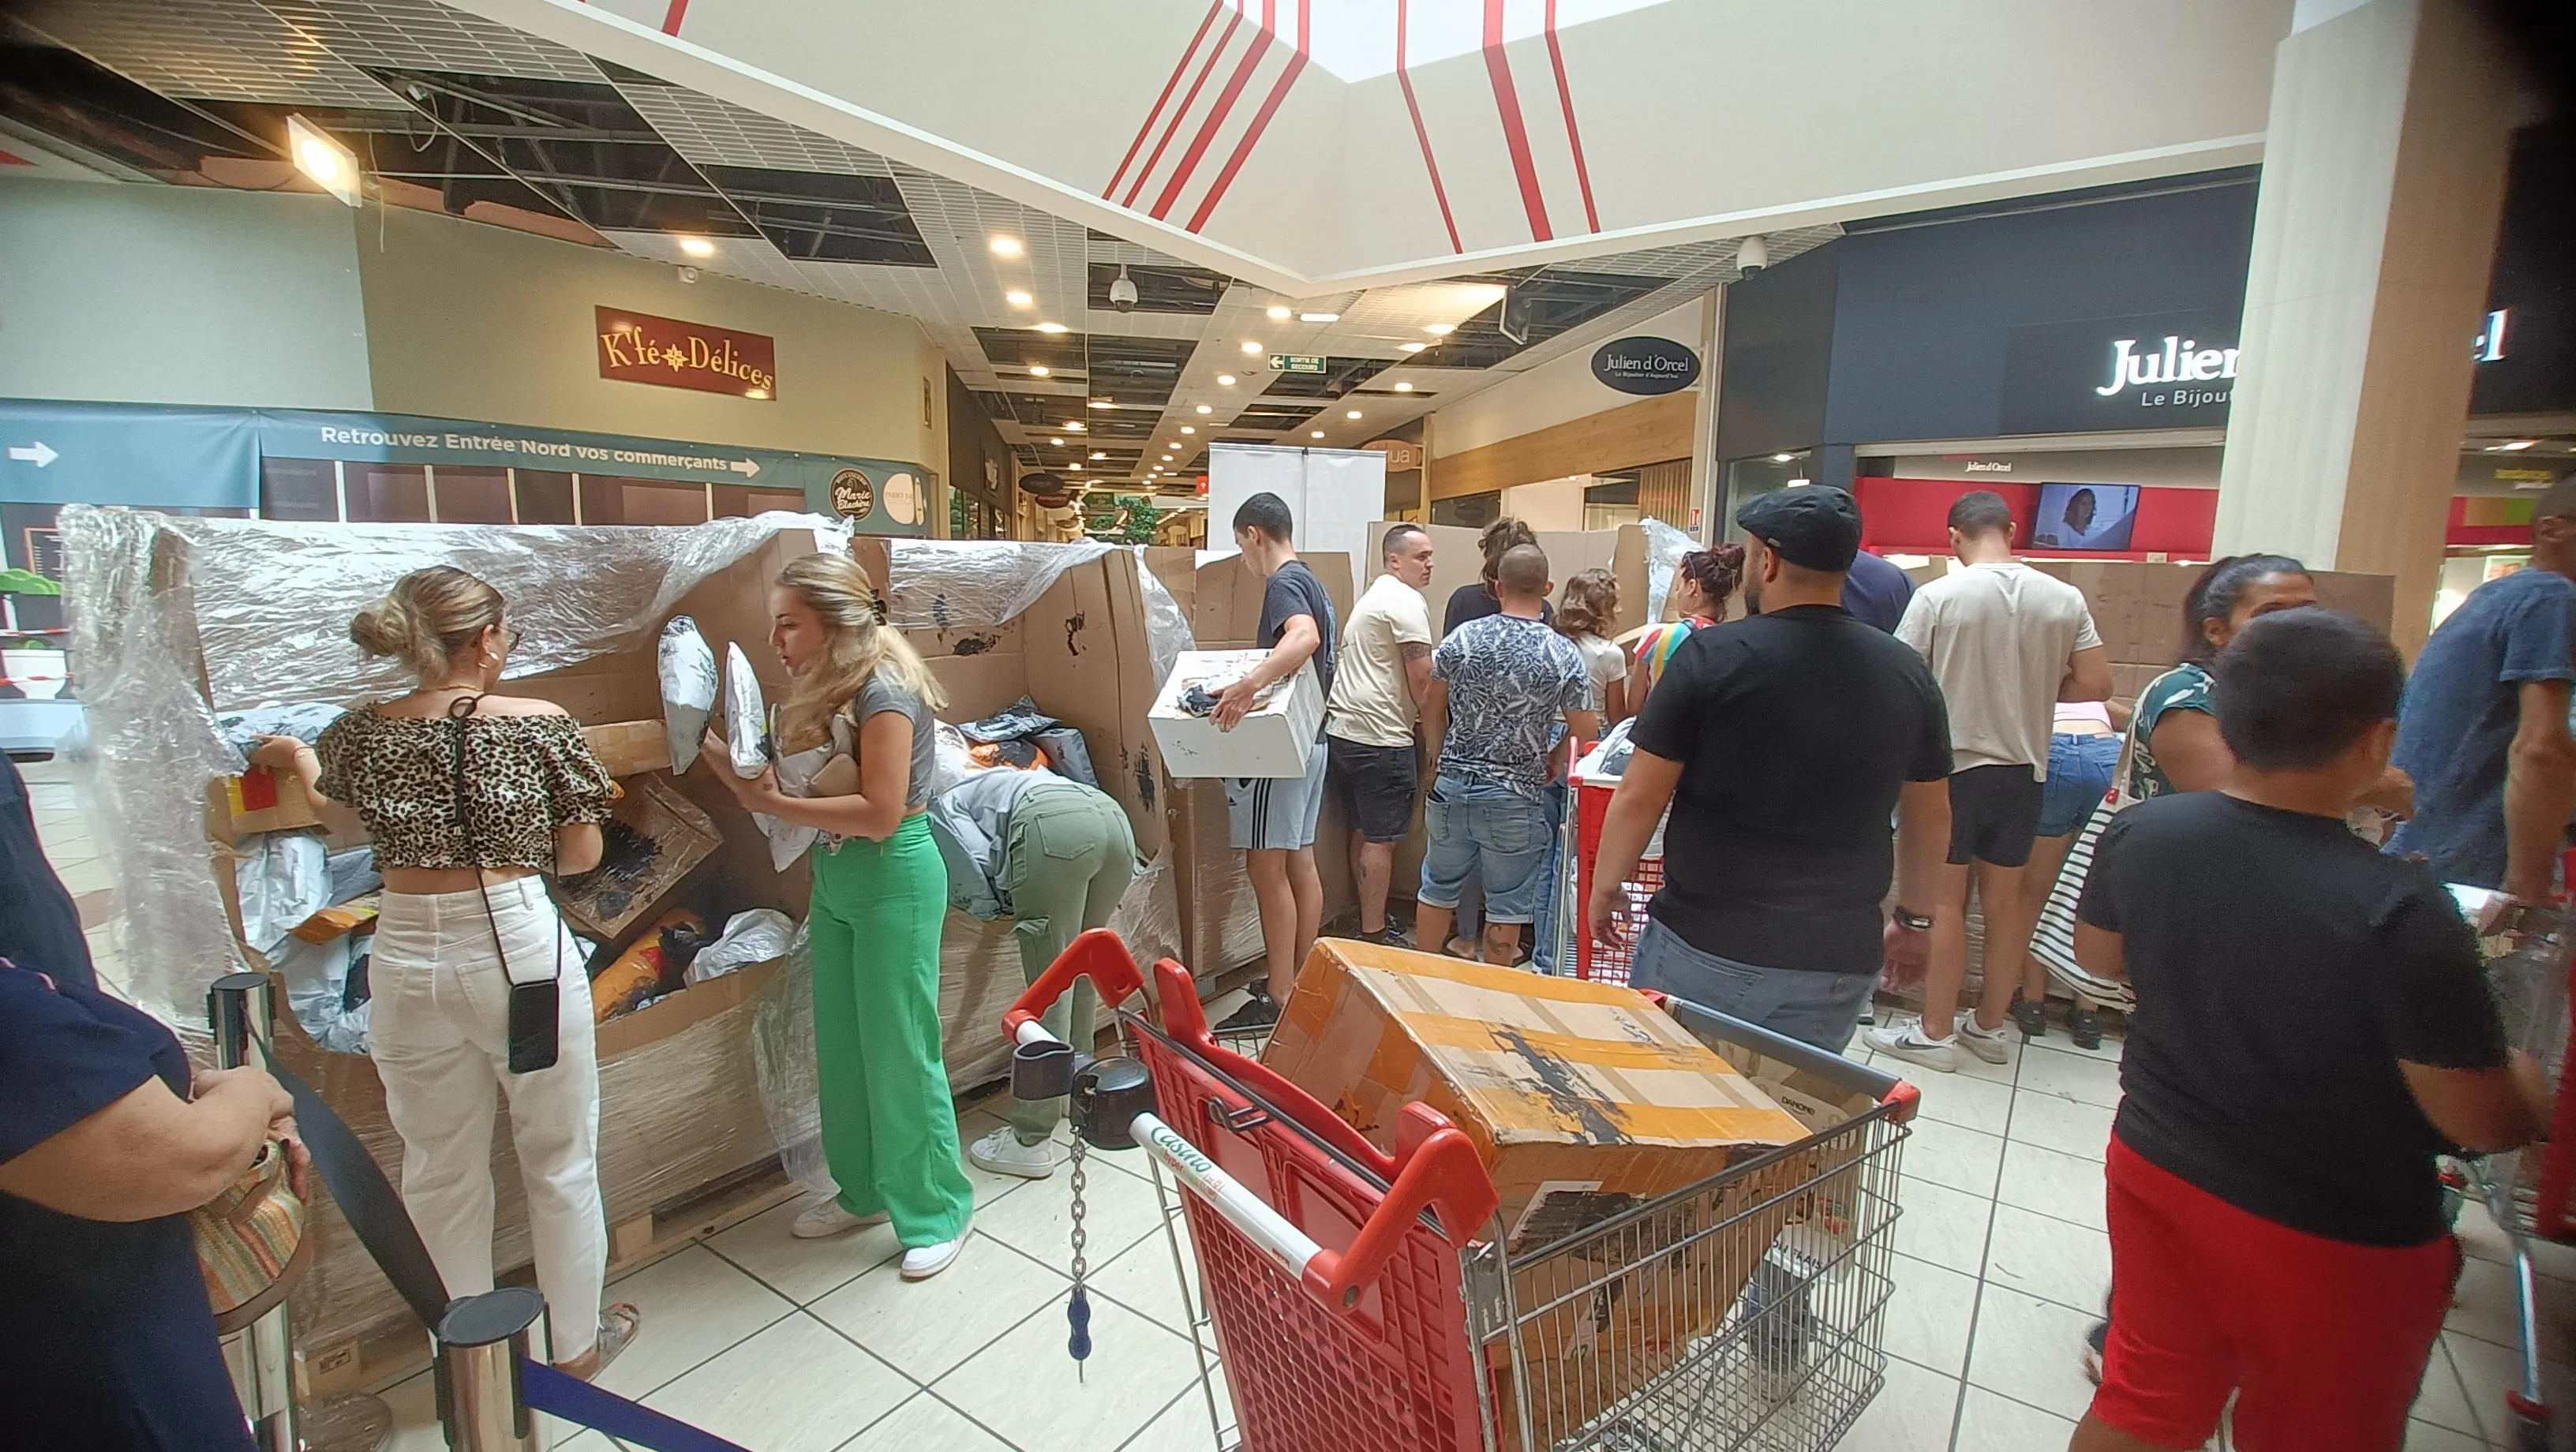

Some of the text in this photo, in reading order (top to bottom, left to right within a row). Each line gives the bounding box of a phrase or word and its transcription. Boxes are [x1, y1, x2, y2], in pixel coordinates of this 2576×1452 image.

[601, 326, 773, 390] K'fé Délices
[1604, 354, 1641, 372] Julien
[2141, 390, 2233, 408] Le Bijou
[321, 426, 727, 470] Retrouvez Entrée Nord vos commerçants
[835, 487, 871, 500] Marie
[1151, 1126, 1212, 1173] Casino
